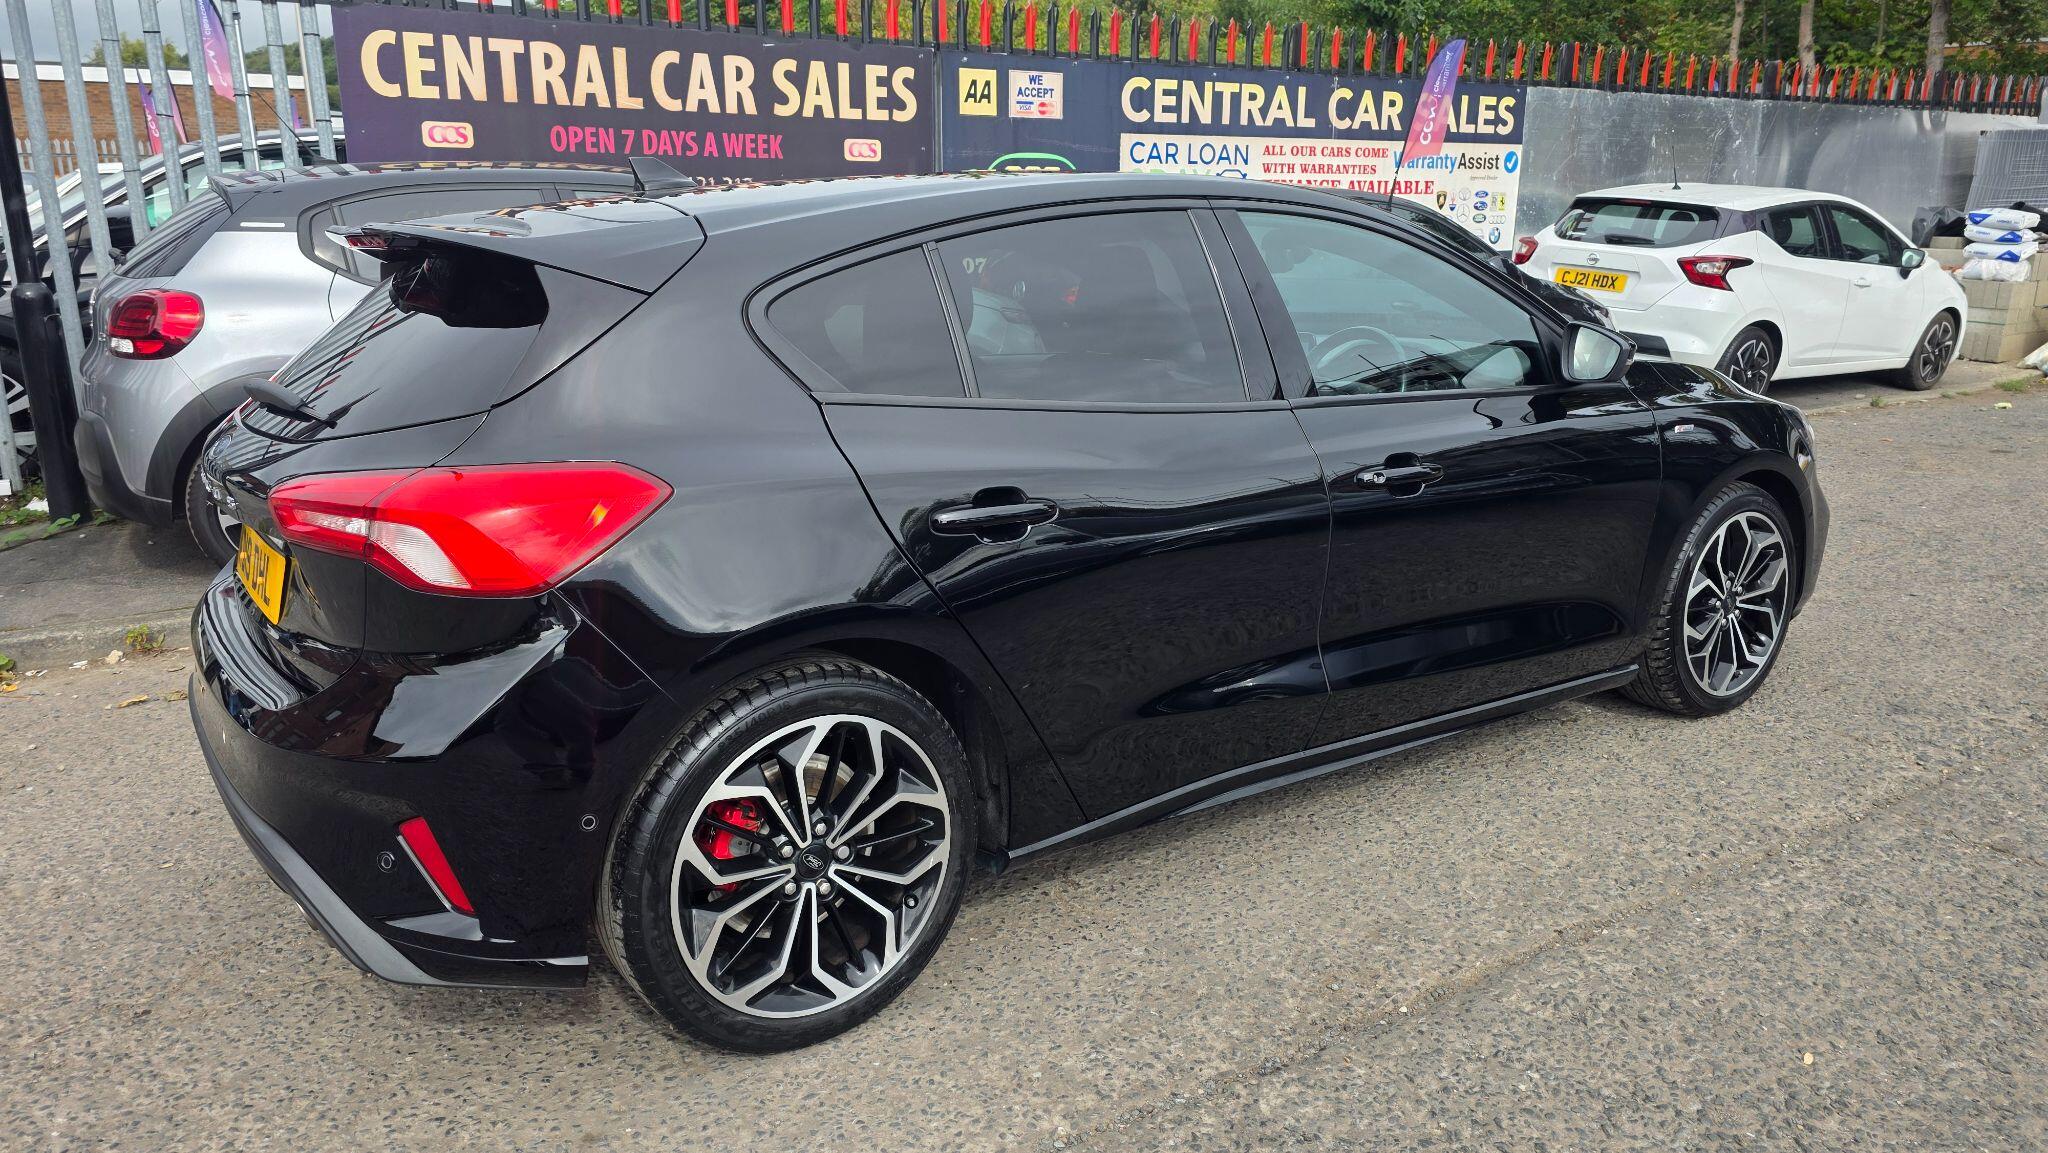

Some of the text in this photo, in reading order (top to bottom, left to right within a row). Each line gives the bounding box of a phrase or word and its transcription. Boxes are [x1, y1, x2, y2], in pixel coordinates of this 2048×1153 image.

[361, 29, 918, 122] CENTRAL CAR SALES
[1028, 74, 1043, 86] WE
[964, 79, 991, 104] AA
[1016, 86, 1055, 99] ACCEPT
[1121, 76, 1516, 136] CENTRAL CAR ALES
[550, 124, 784, 159] OPEN 7 DAYS A WEEK
[1129, 141, 1249, 166] CAR LOAN
[1262, 145, 1389, 159] ALL OUR CARS COME
[1262, 162, 1377, 175] WITH WARRANTIES
[1348, 179, 1435, 195] AVAILABLE
[1561, 271, 1618, 290] CJ21 HDX
